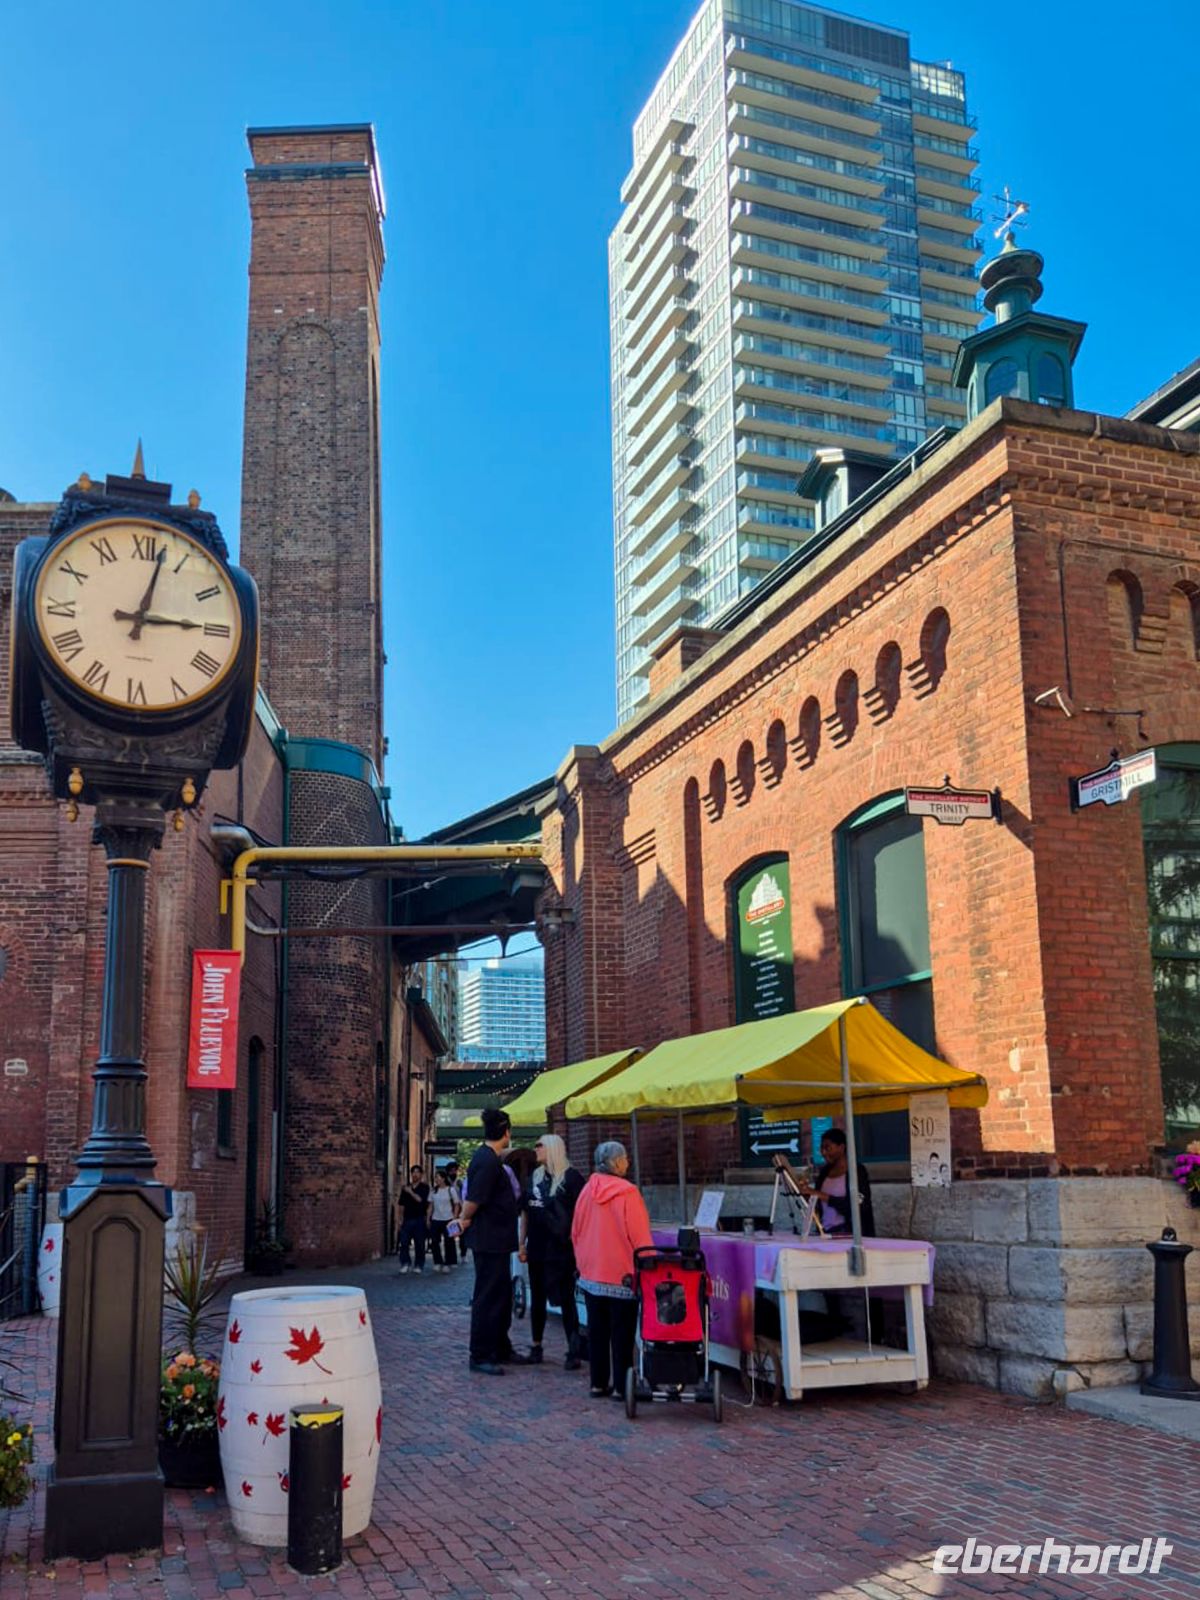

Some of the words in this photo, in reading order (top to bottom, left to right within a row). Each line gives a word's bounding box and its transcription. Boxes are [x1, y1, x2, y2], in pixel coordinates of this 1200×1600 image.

[90, 536, 118, 566] XI
[132, 533, 156, 562] XII
[59, 560, 88, 586] X
[195, 585, 221, 602] II
[47, 597, 76, 618] IX
[204, 622, 230, 638] III
[52, 629, 85, 662] VIII
[82, 661, 110, 694] VII
[127, 678, 148, 705] VI
[930, 803, 970, 814] TRINITY
[202, 963, 232, 1003] JOHN
[198, 1007, 230, 1076] FLUEVOG
[911, 1116, 934, 1137] $10
